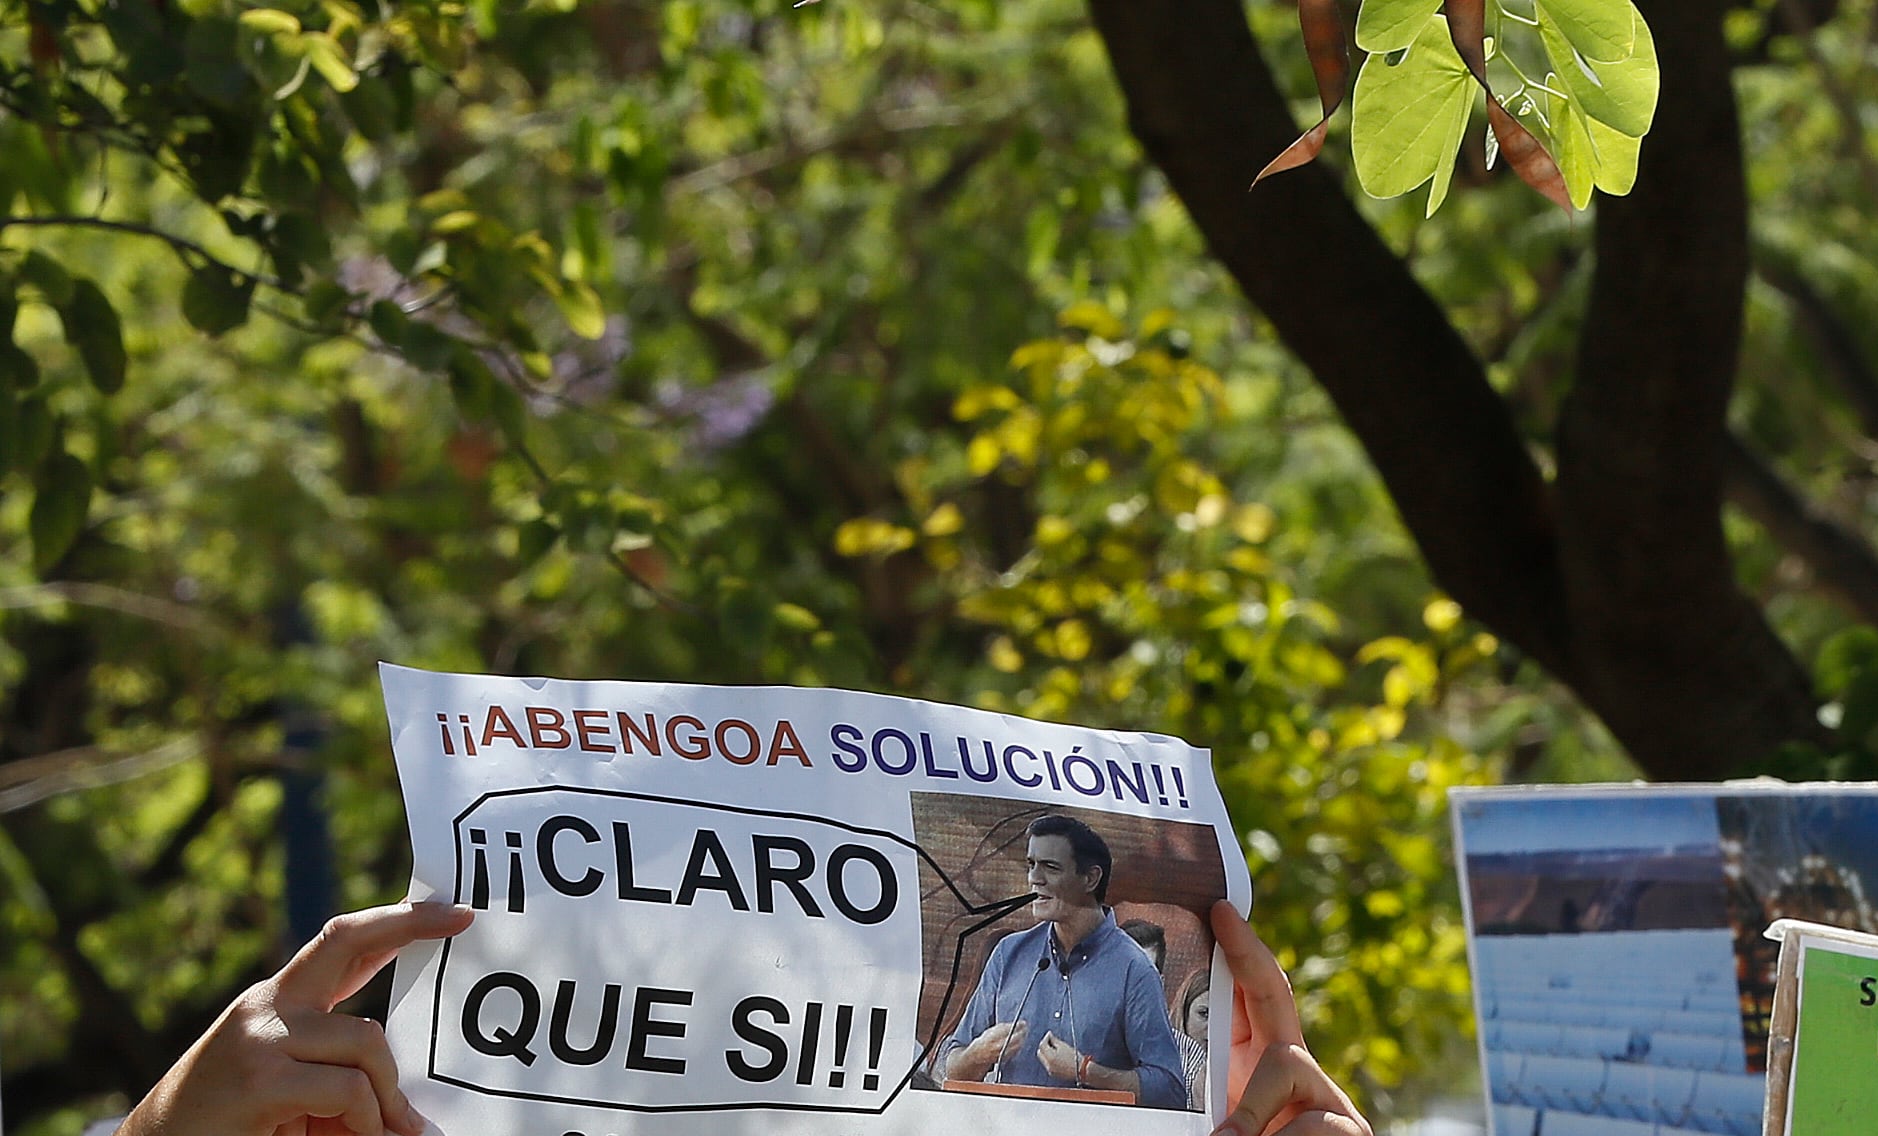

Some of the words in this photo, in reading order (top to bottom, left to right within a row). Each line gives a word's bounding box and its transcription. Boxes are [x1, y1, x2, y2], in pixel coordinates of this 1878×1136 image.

[436, 705, 813, 768] ¡¡ABENGOA
[830, 724, 1190, 809] SOLUCIÓN!!
[469, 815, 899, 925] ¡¡CLARO
[461, 971, 694, 1067] QUE
[725, 996, 888, 1091] SI!!
